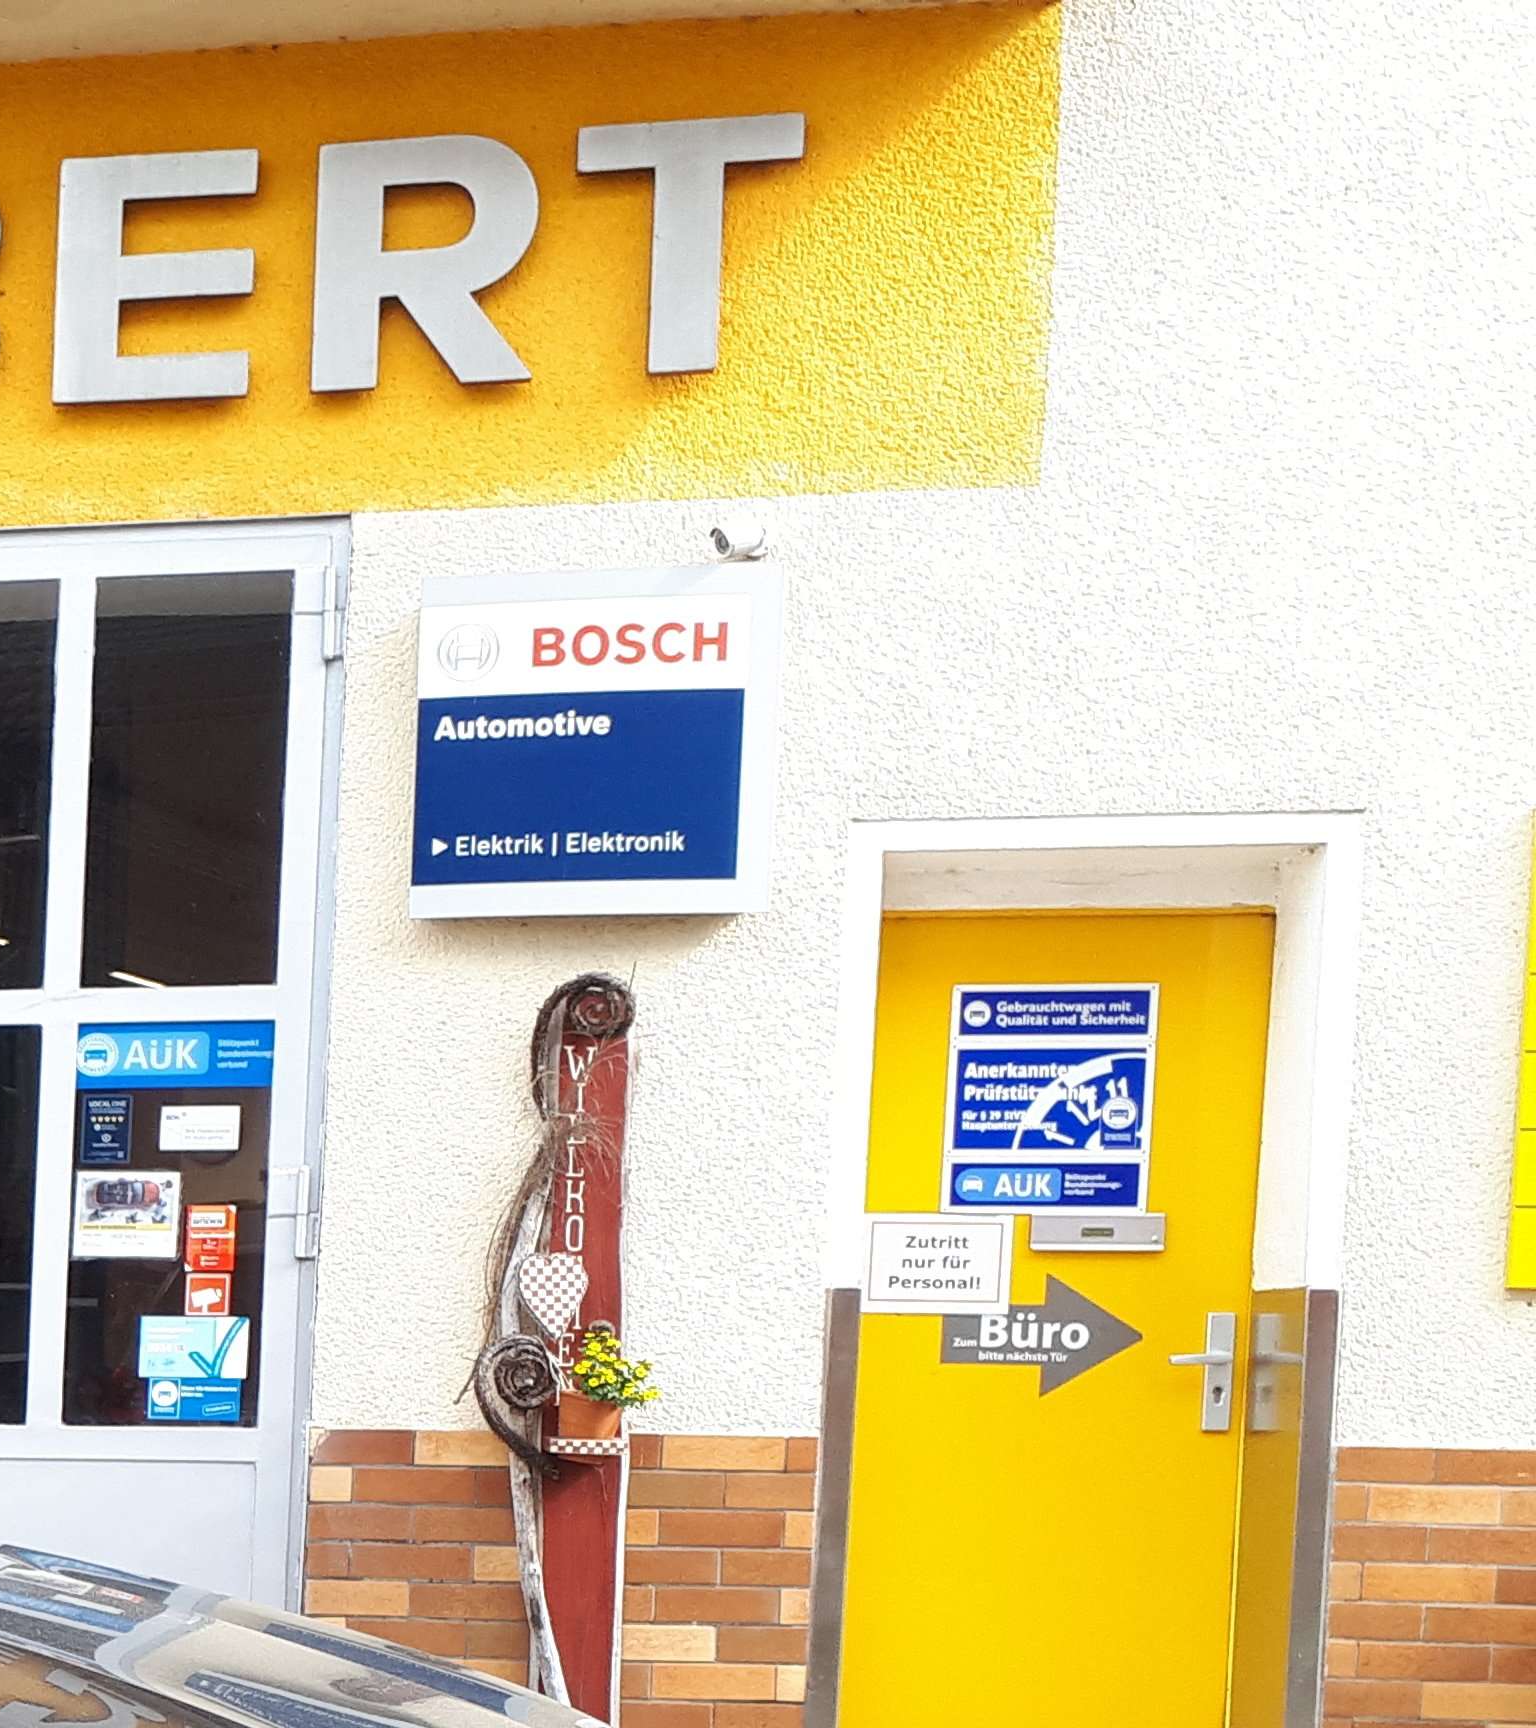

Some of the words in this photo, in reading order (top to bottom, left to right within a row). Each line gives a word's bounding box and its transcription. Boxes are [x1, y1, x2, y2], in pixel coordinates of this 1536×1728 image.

[531, 621, 729, 668] BOSCH
[433, 710, 611, 741] Automotive
[455, 832, 544, 857] Elektrik
[565, 830, 686, 855] Elektronik
[996, 1000, 1107, 1016] Gebrauchtwagen
[1107, 1000, 1132, 1013] mit
[995, 1012, 1049, 1027] Qualität
[1051, 1013, 1077, 1026] und
[1080, 1013, 1146, 1026] Sicherheit
[556, 1045, 598, 1406] WILLKOEN
[905, 1234, 969, 1250] Zutritt
[901, 1257, 936, 1271] nur
[942, 1255, 971, 1271] für
[887, 1275, 981, 1291] Personal!
[953, 1336, 978, 1348] Zum
[979, 1311, 1090, 1352] Büro
[978, 1350, 1004, 1362] bitte
[1006, 1350, 1048, 1363] nächste
[1050, 1350, 1069, 1364] Tür
